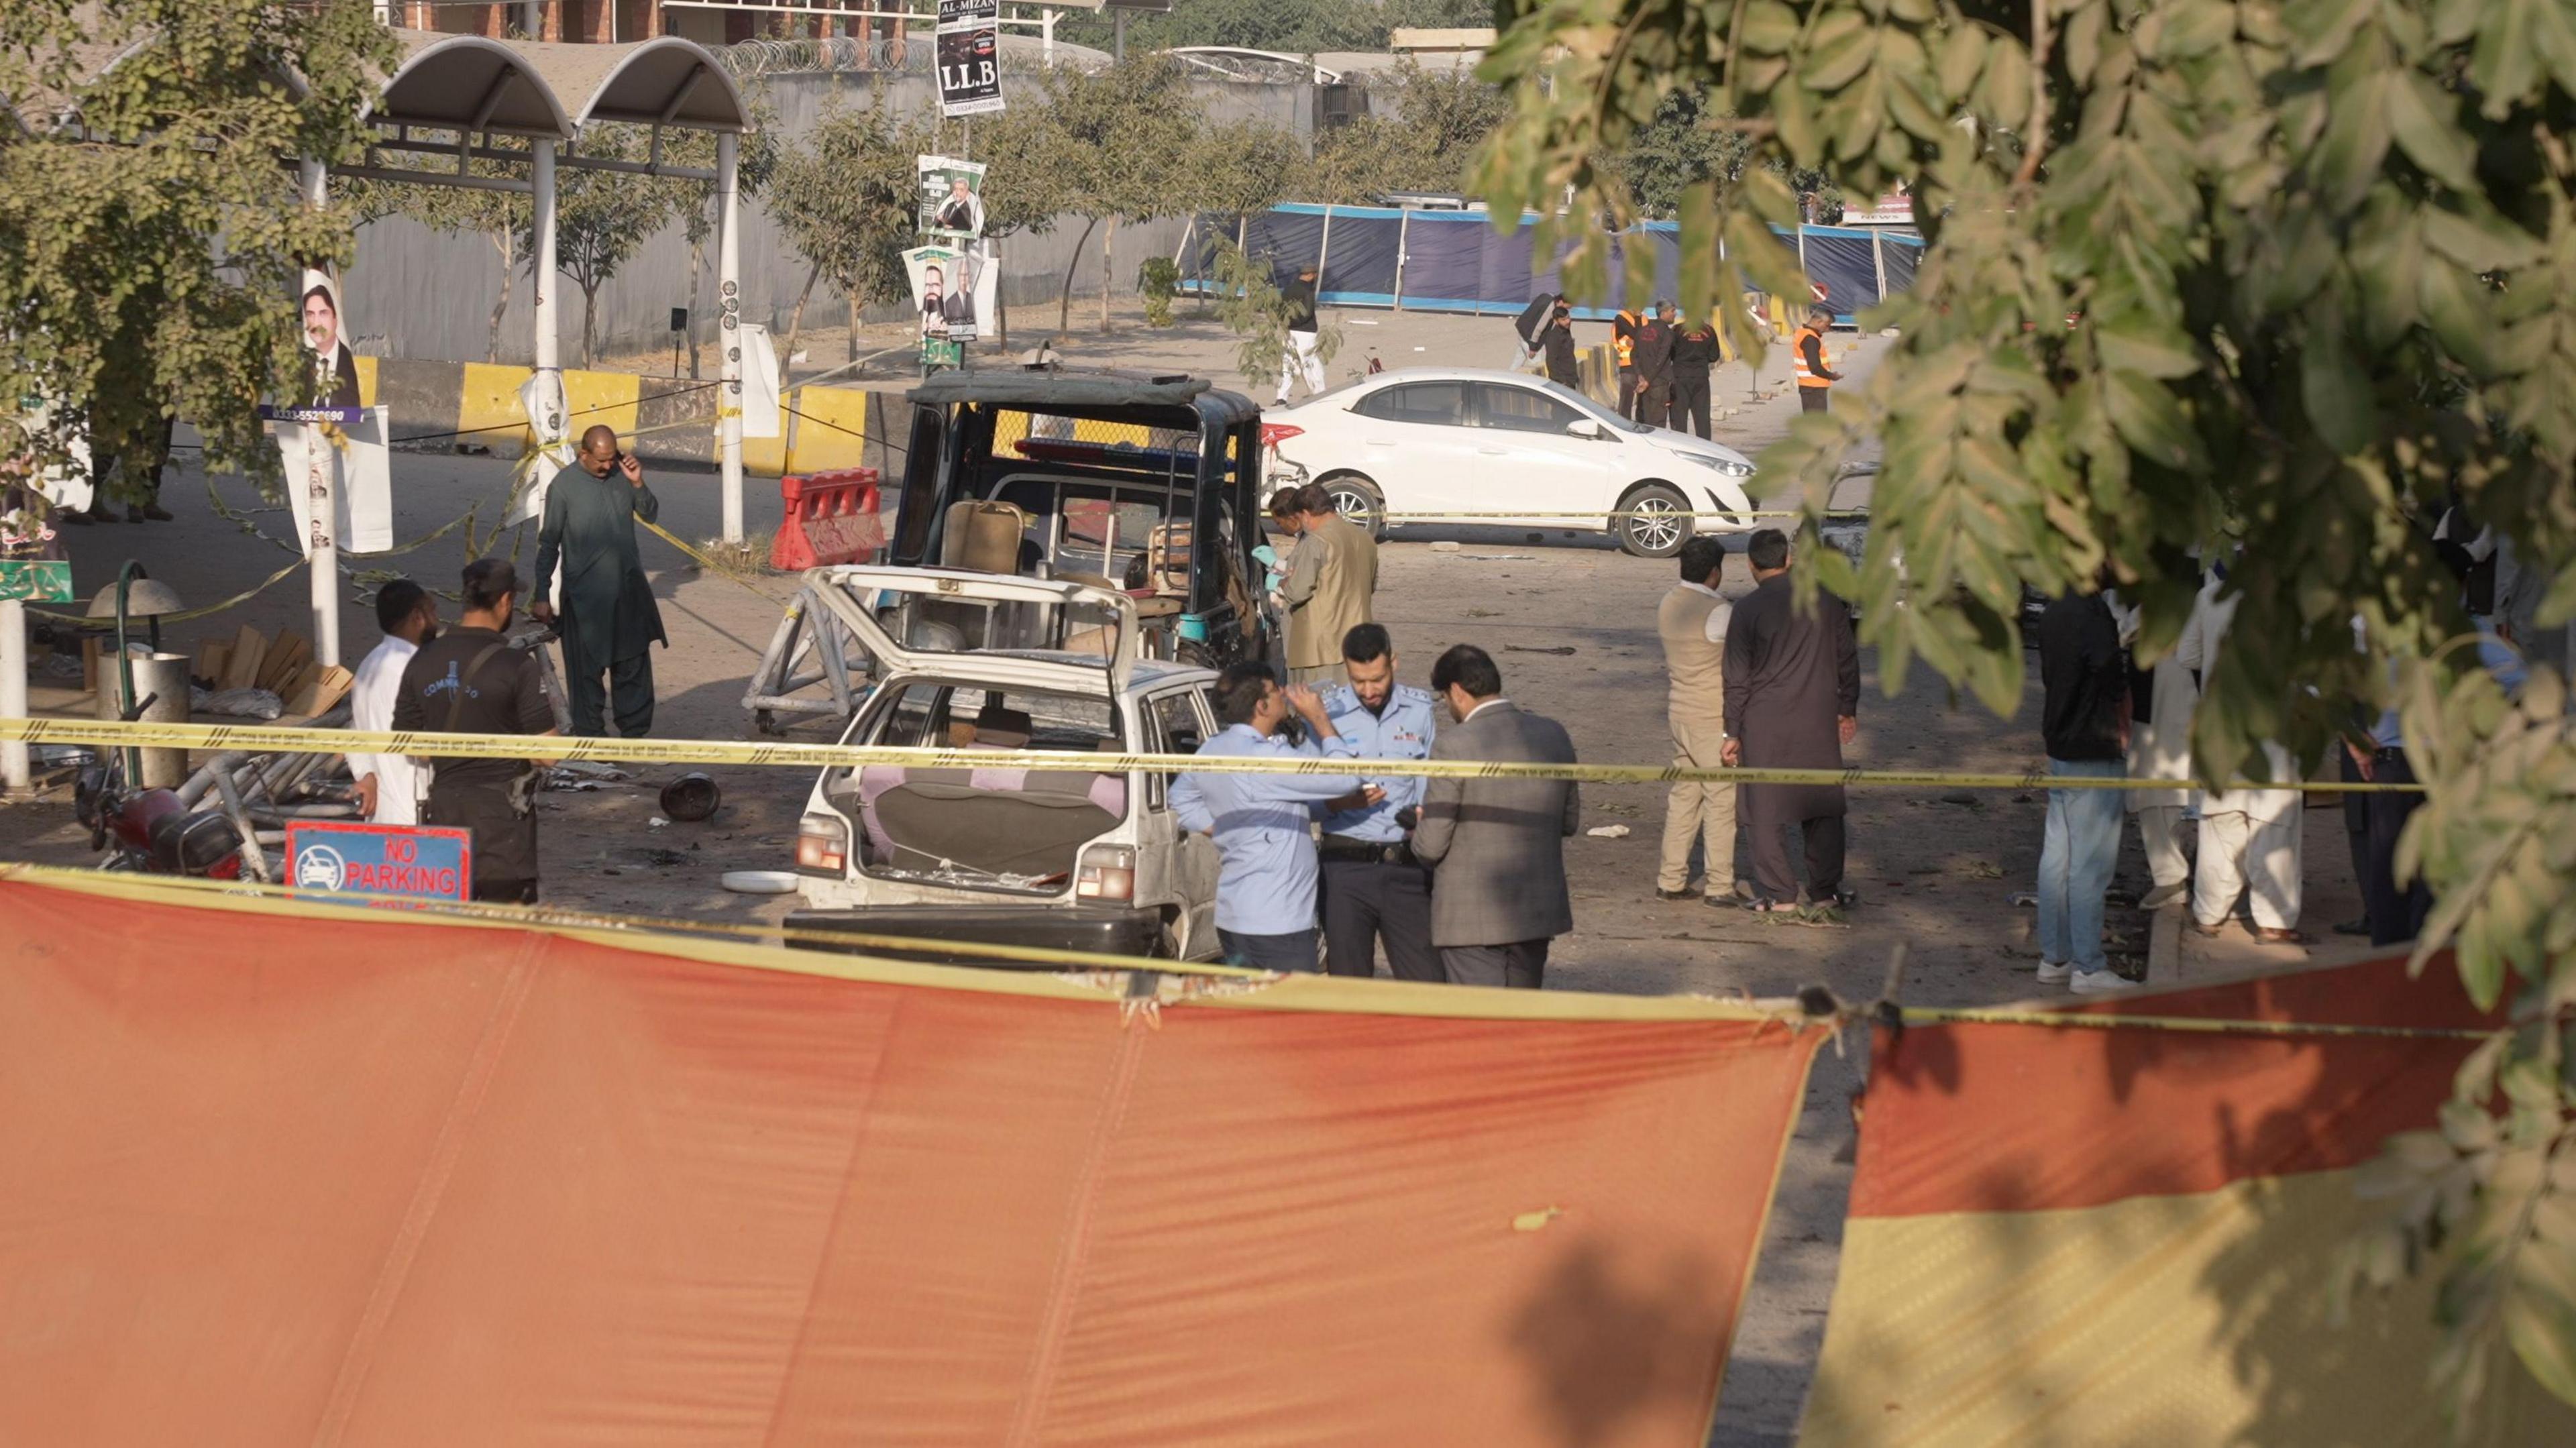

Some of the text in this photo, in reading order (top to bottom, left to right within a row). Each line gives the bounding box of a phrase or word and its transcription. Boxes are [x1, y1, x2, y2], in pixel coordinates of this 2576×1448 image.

[941, 0, 996, 13] AL-MIZAN
[941, 60, 996, 91] LL.B
[384, 838, 418, 864] NO
[345, 861, 455, 895] PARKING
